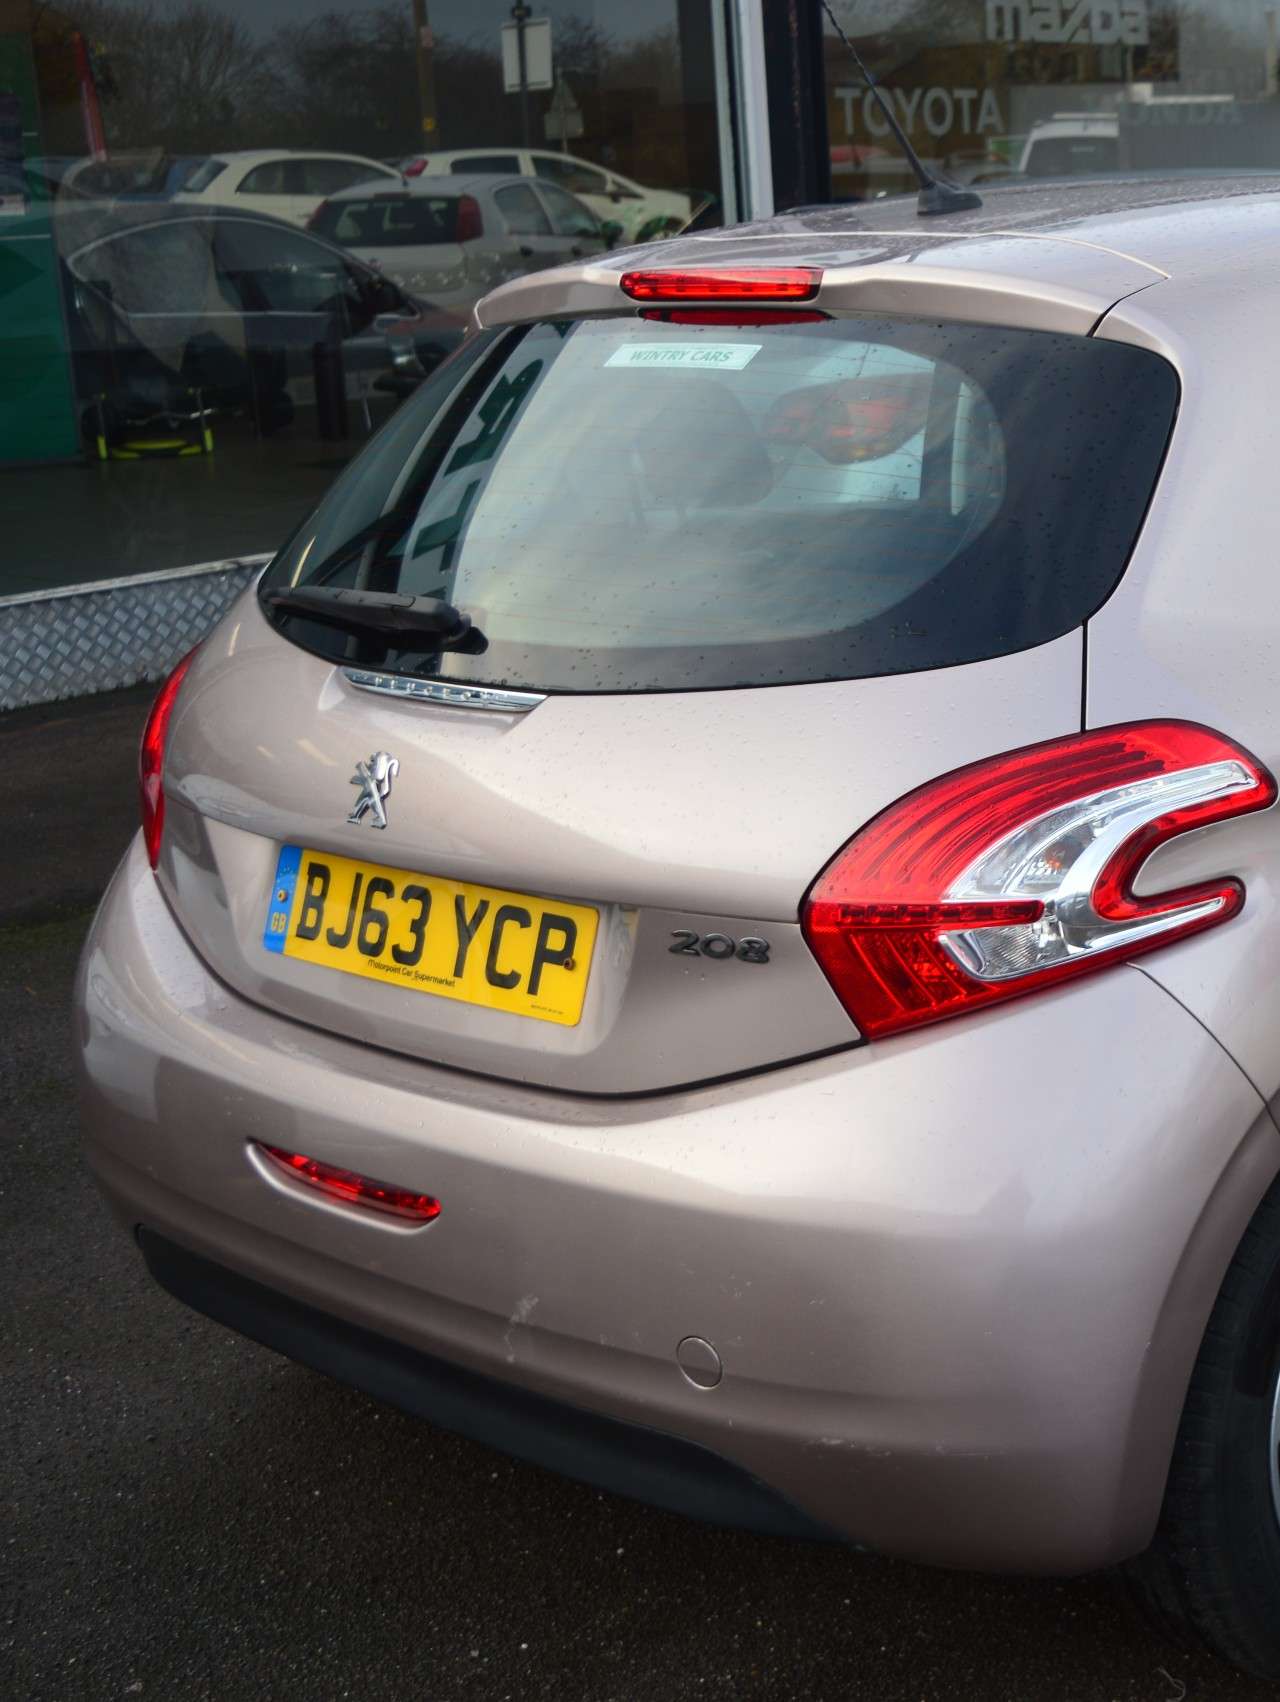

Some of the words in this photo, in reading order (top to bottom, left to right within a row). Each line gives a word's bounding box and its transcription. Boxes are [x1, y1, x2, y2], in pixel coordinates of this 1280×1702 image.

[833, 86, 1004, 136] TOYOTA
[630, 350, 689, 361] WINTRY
[691, 350, 735, 362] CARS
[271, 911, 288, 933] GB
[295, 862, 432, 967] BJ63
[452, 893, 578, 997] YCP
[667, 929, 770, 964] 208
[401, 966, 413, 977] Car
[413, 970, 456, 988] Supermarket
